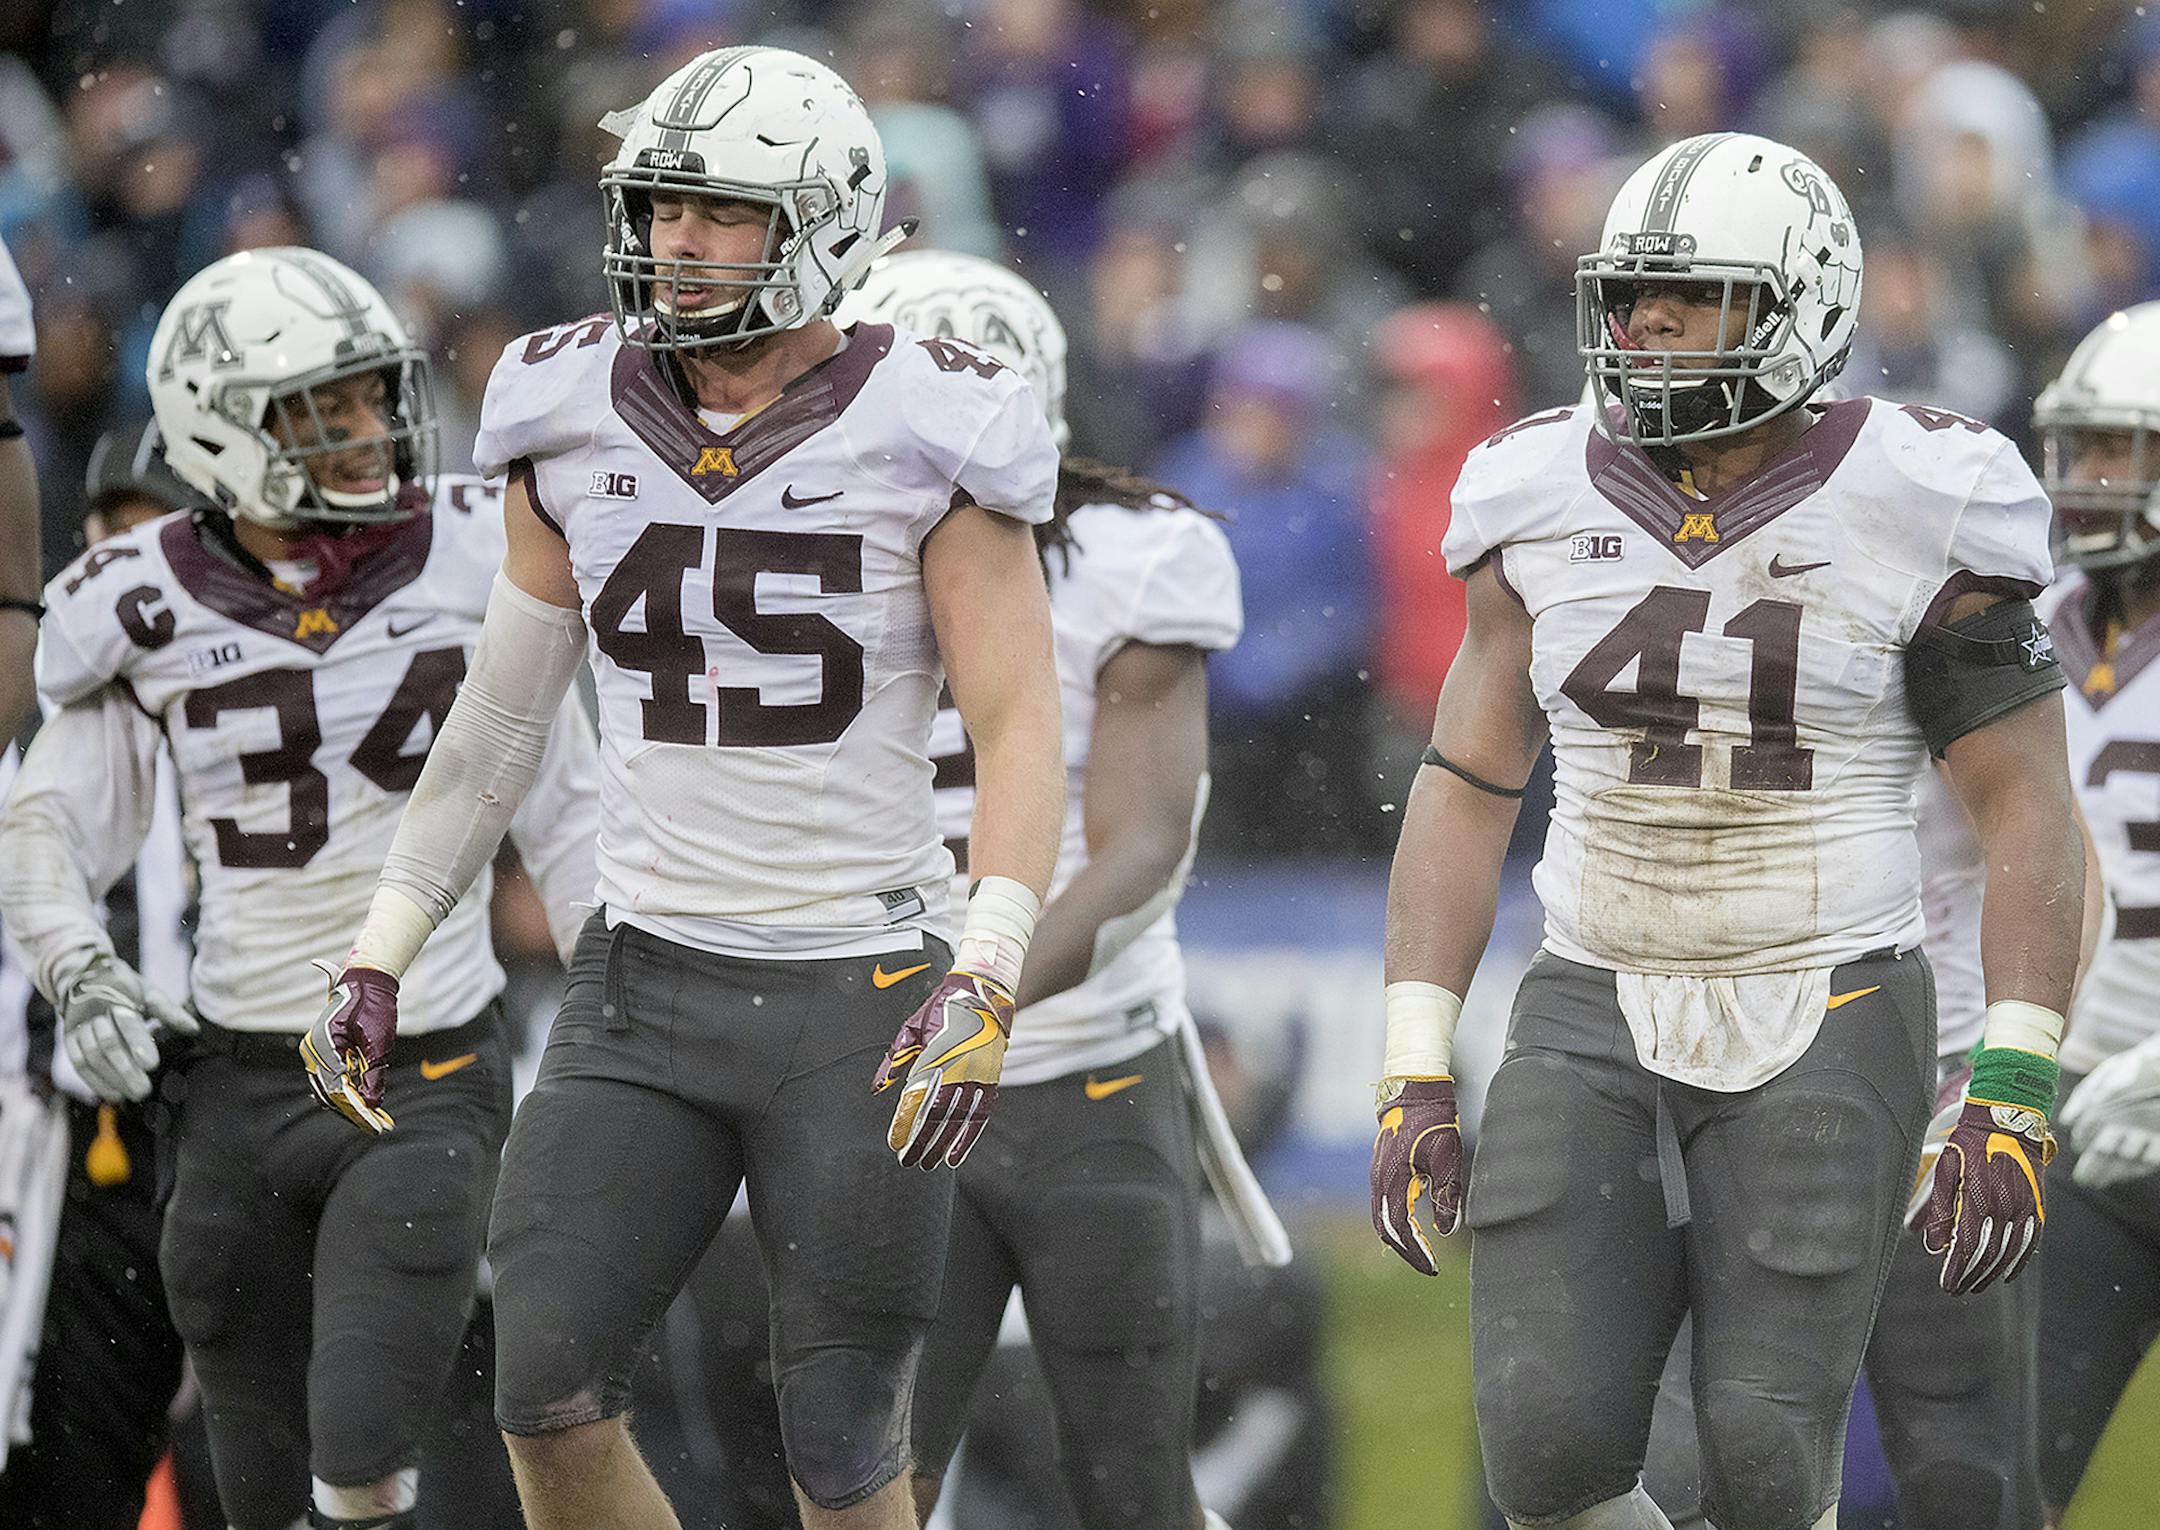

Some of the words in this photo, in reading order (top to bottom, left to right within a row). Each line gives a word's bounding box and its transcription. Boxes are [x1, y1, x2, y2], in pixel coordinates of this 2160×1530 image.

[650, 153, 684, 169] ROW
[1659, 158, 1690, 212] BOAT
[1635, 236, 1671, 253] ROW
[159, 298, 244, 384] M
[691, 447, 740, 477] M
[1674, 513, 1719, 543] M
[116, 585, 176, 650] C
[295, 608, 339, 638] M
[590, 521, 865, 747] 45
[1560, 585, 1814, 791] 41
[185, 645, 468, 869] 34
